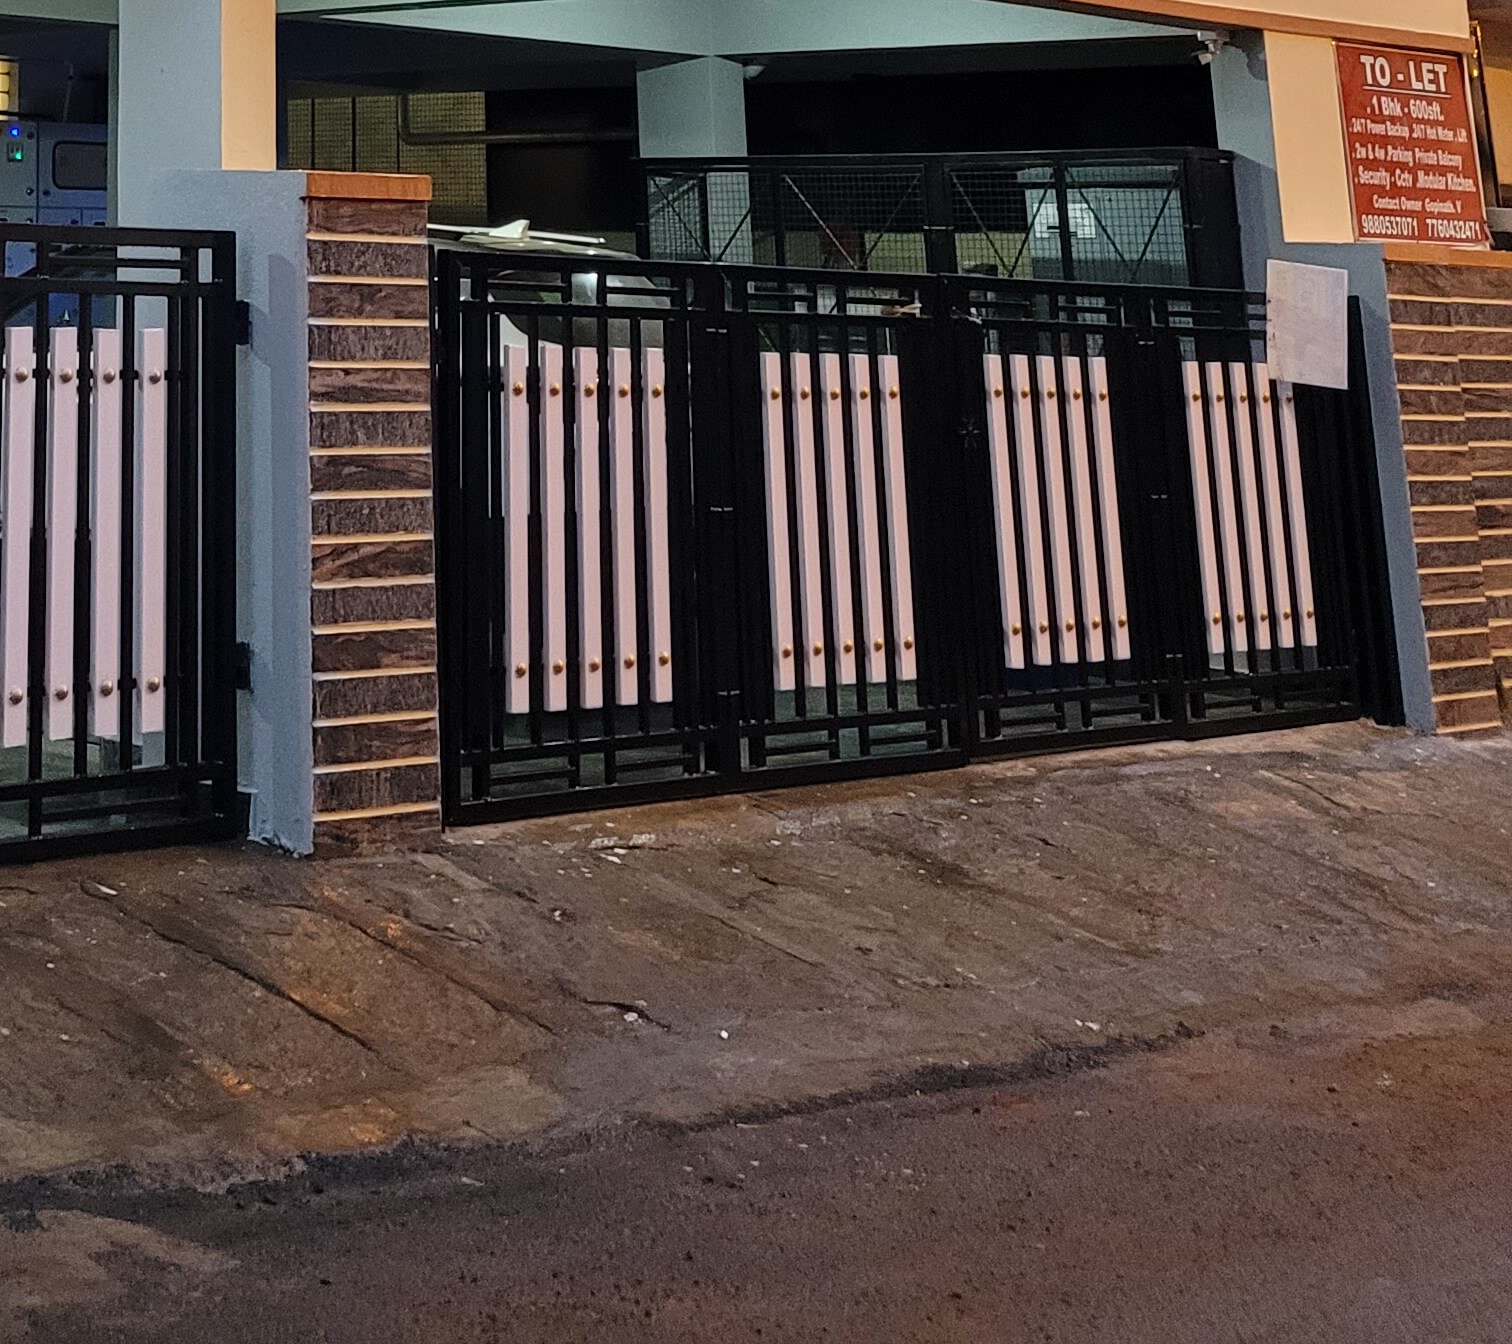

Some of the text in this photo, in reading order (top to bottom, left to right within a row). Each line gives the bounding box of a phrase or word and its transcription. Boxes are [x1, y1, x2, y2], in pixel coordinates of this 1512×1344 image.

[1359, 54, 1391, 87] TO
[1408, 60, 1448, 93] LET
[1380, 95, 1403, 117] Bhk
[1361, 213, 1482, 240] 9880537071 7760432471
